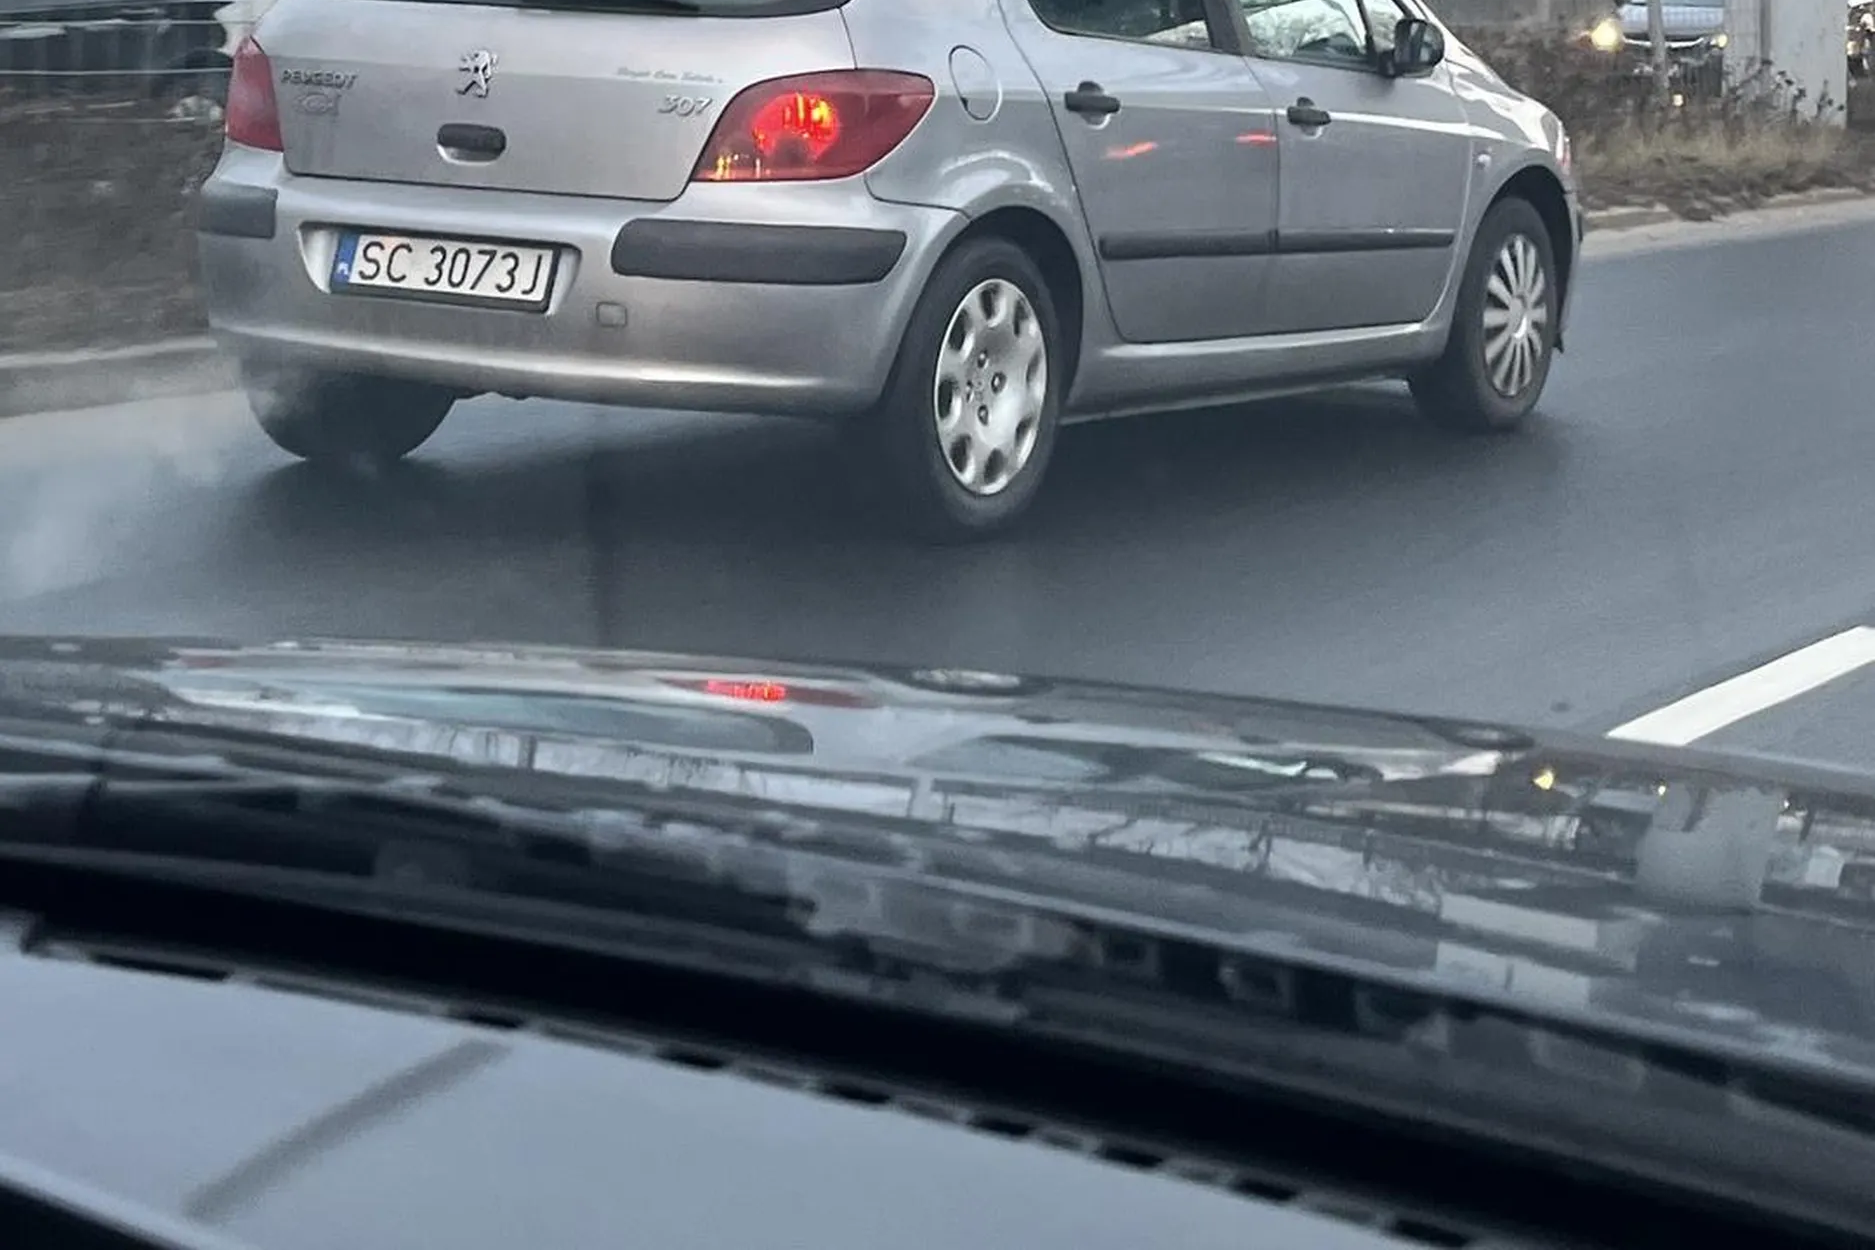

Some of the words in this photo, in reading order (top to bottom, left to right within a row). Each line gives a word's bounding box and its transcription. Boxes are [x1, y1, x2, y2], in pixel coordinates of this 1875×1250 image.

[281, 69, 358, 89] PEUGEOT
[658, 94, 713, 117] 307
[358, 241, 413, 283] SC
[424, 245, 543, 296] 3073J
